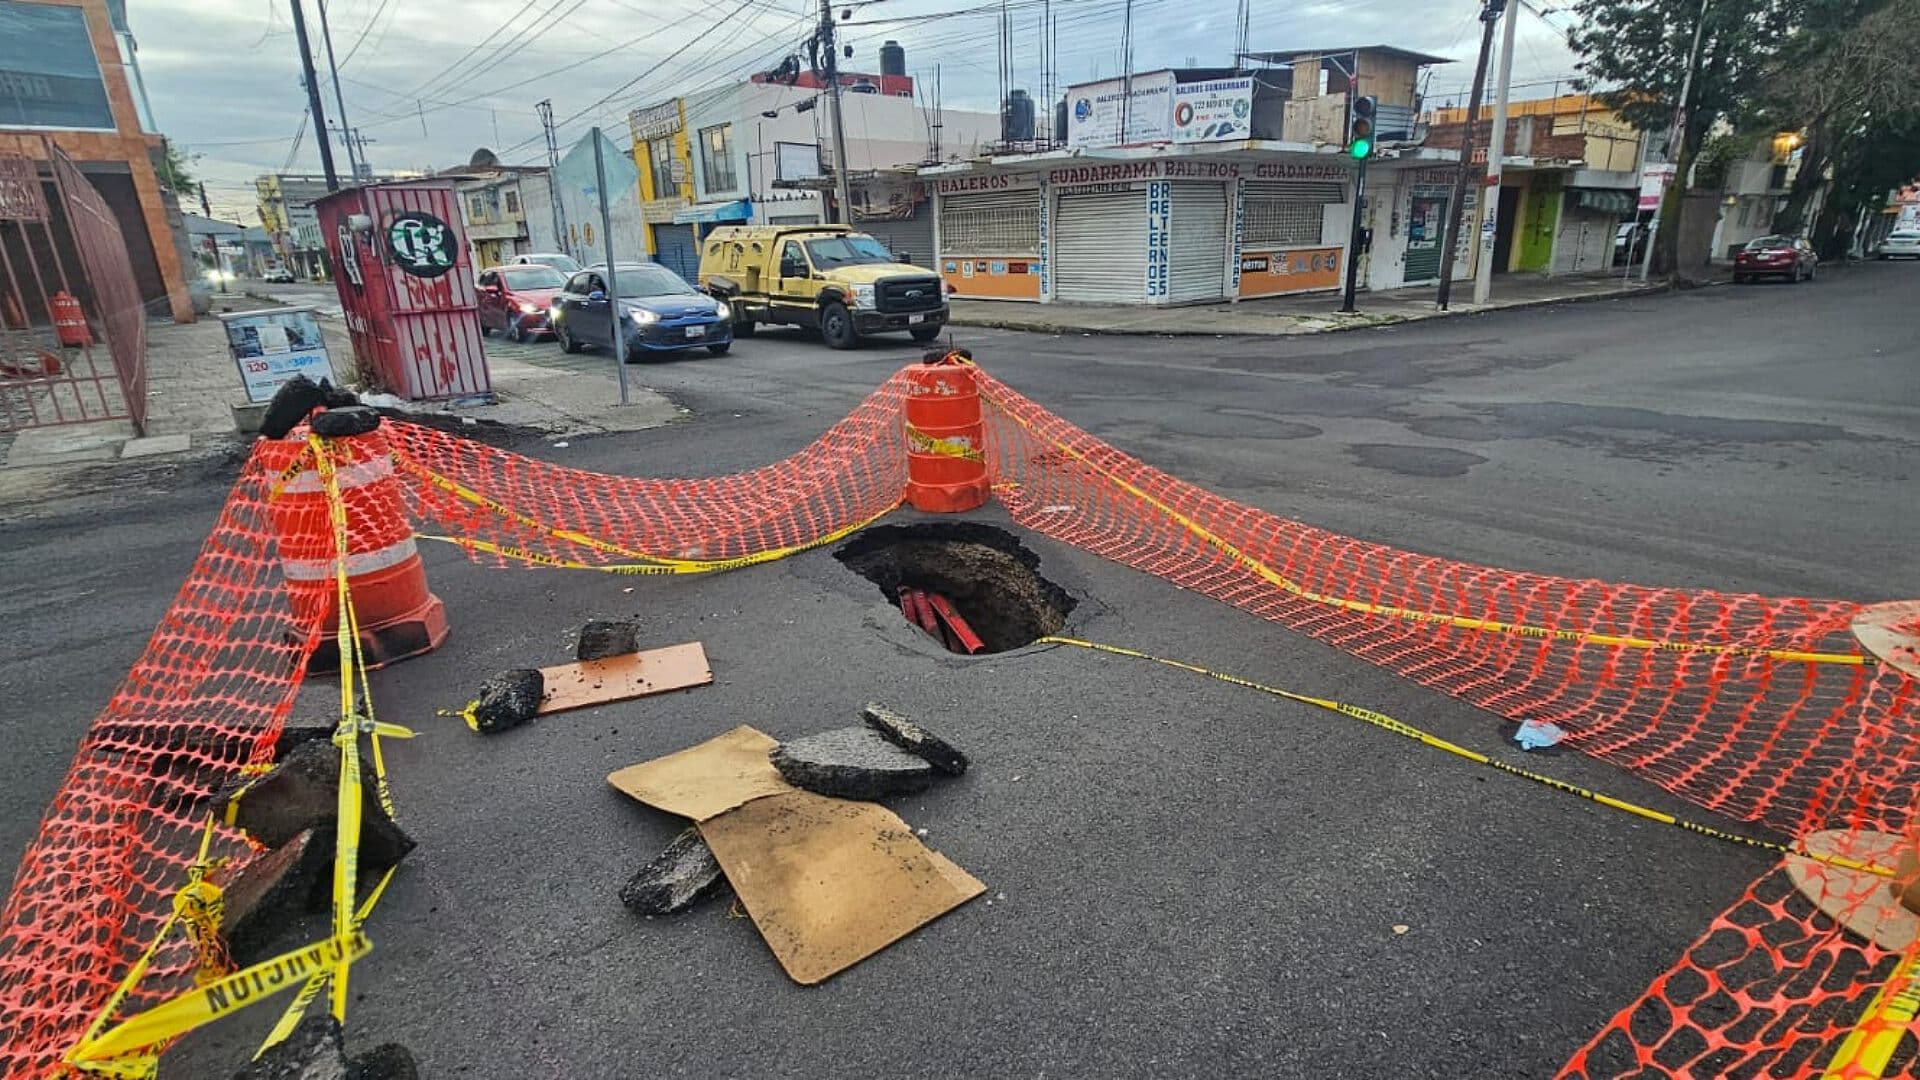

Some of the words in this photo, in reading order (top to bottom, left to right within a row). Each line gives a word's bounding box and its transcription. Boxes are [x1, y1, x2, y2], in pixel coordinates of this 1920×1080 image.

[1050, 161, 1158, 184] GUADARRAMA
[1165, 161, 1239, 178] BALEROS
[1257, 164, 1348, 179] GUADARRAMA
[941, 174, 1008, 193] BALEROS
[1148, 183, 1159, 295] BALEROS
[1159, 183, 1169, 295] RETENES
